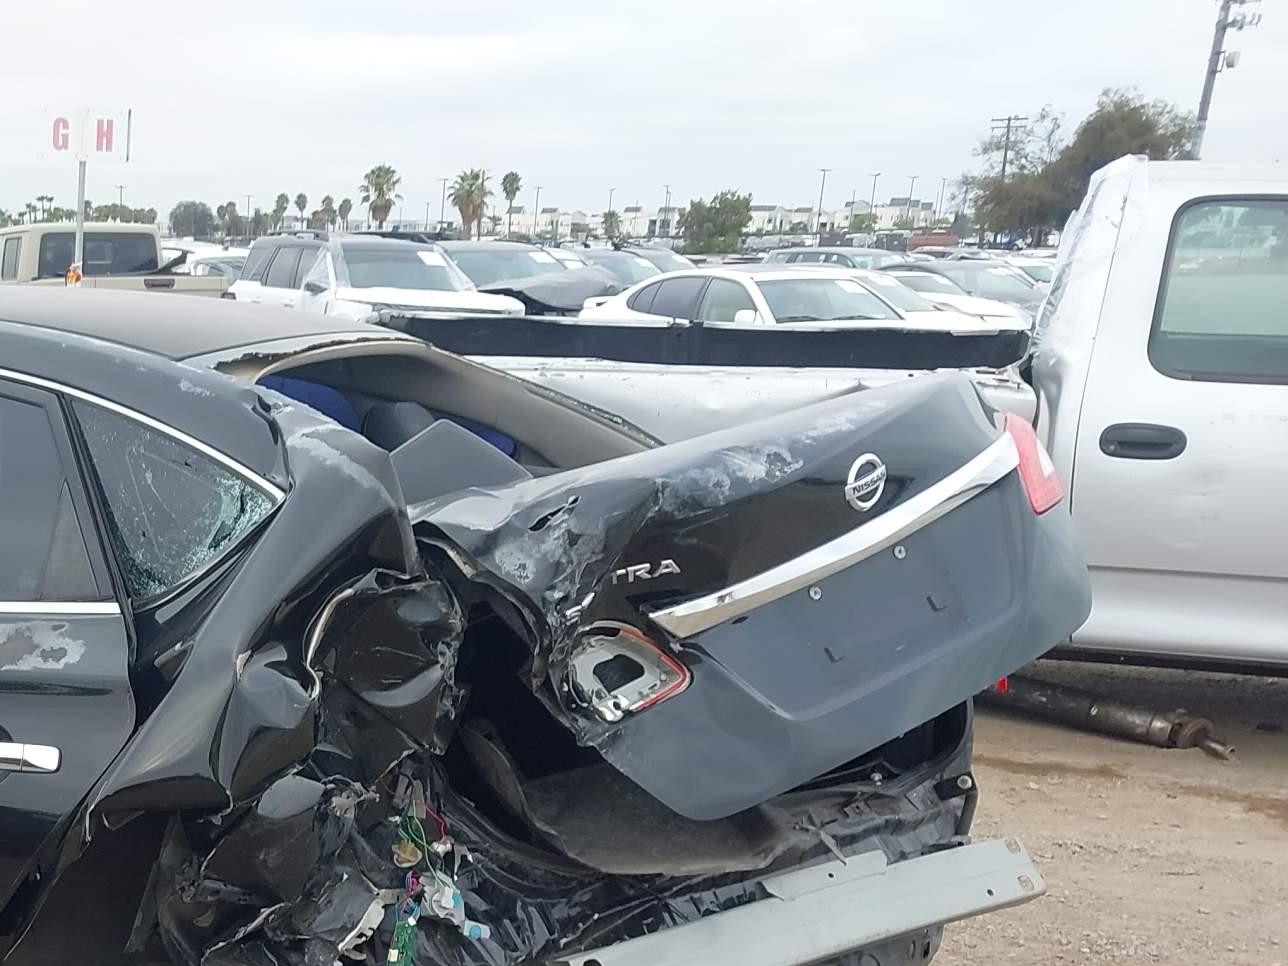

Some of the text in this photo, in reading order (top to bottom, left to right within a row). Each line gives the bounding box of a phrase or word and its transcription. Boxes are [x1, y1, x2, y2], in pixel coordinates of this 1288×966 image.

[52, 116, 114, 153] G H
[852, 471, 886, 496] NISSAN
